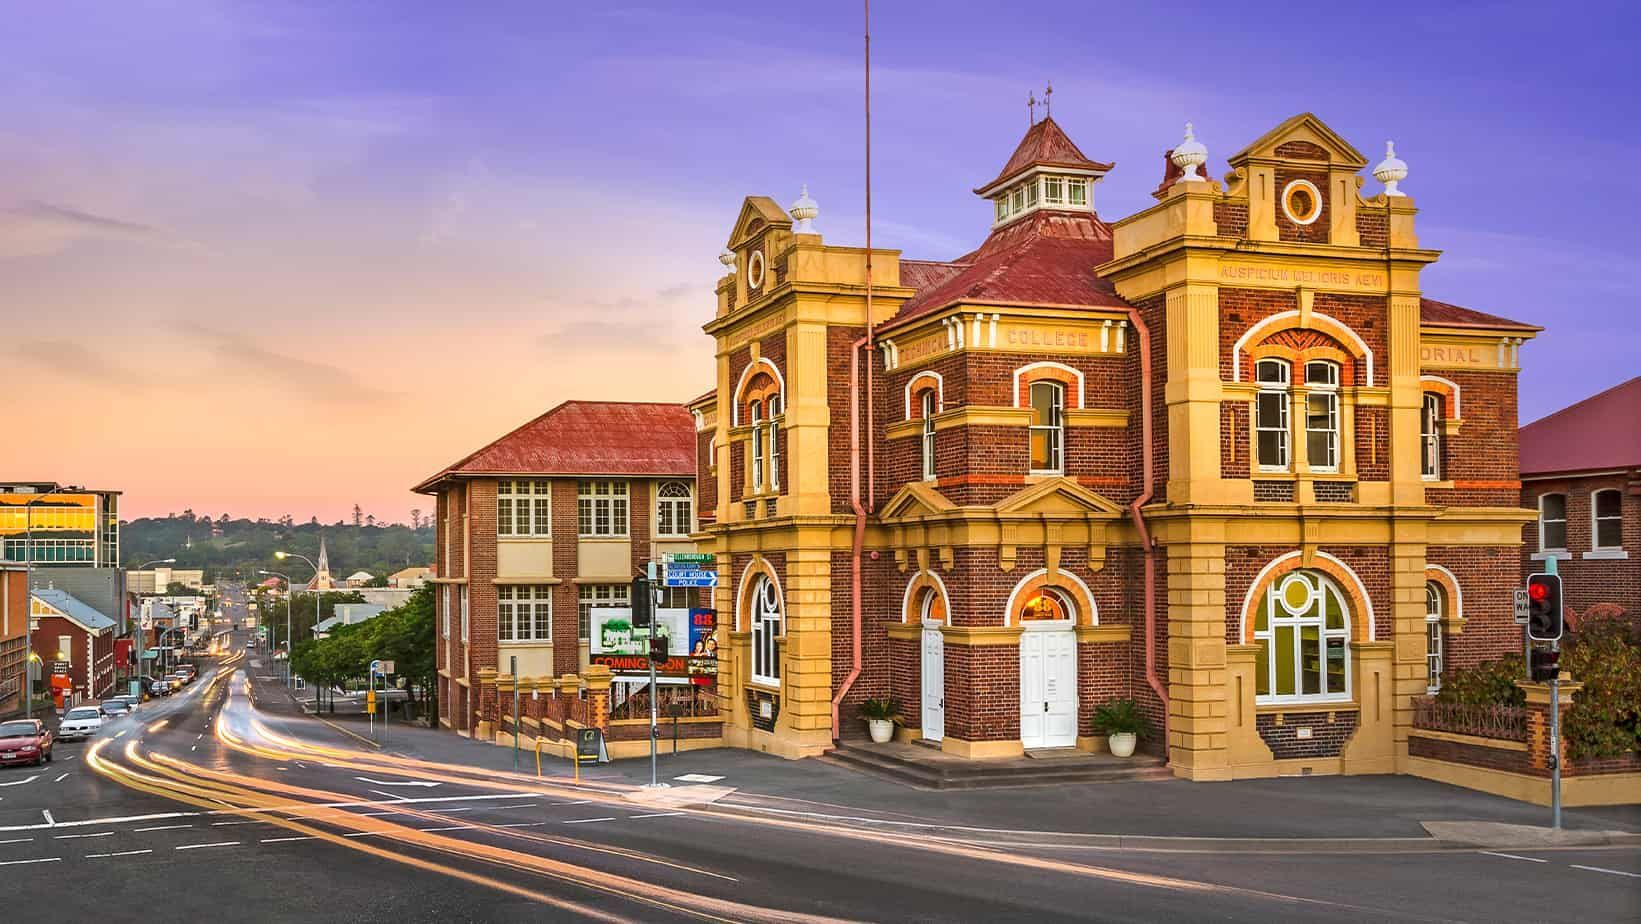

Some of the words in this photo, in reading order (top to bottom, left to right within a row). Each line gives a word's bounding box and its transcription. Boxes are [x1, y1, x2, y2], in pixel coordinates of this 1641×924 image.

[1007, 329, 1089, 347] COLLEGE
[1420, 347, 1480, 362] ORIAL
[594, 656, 647, 669] COMING
